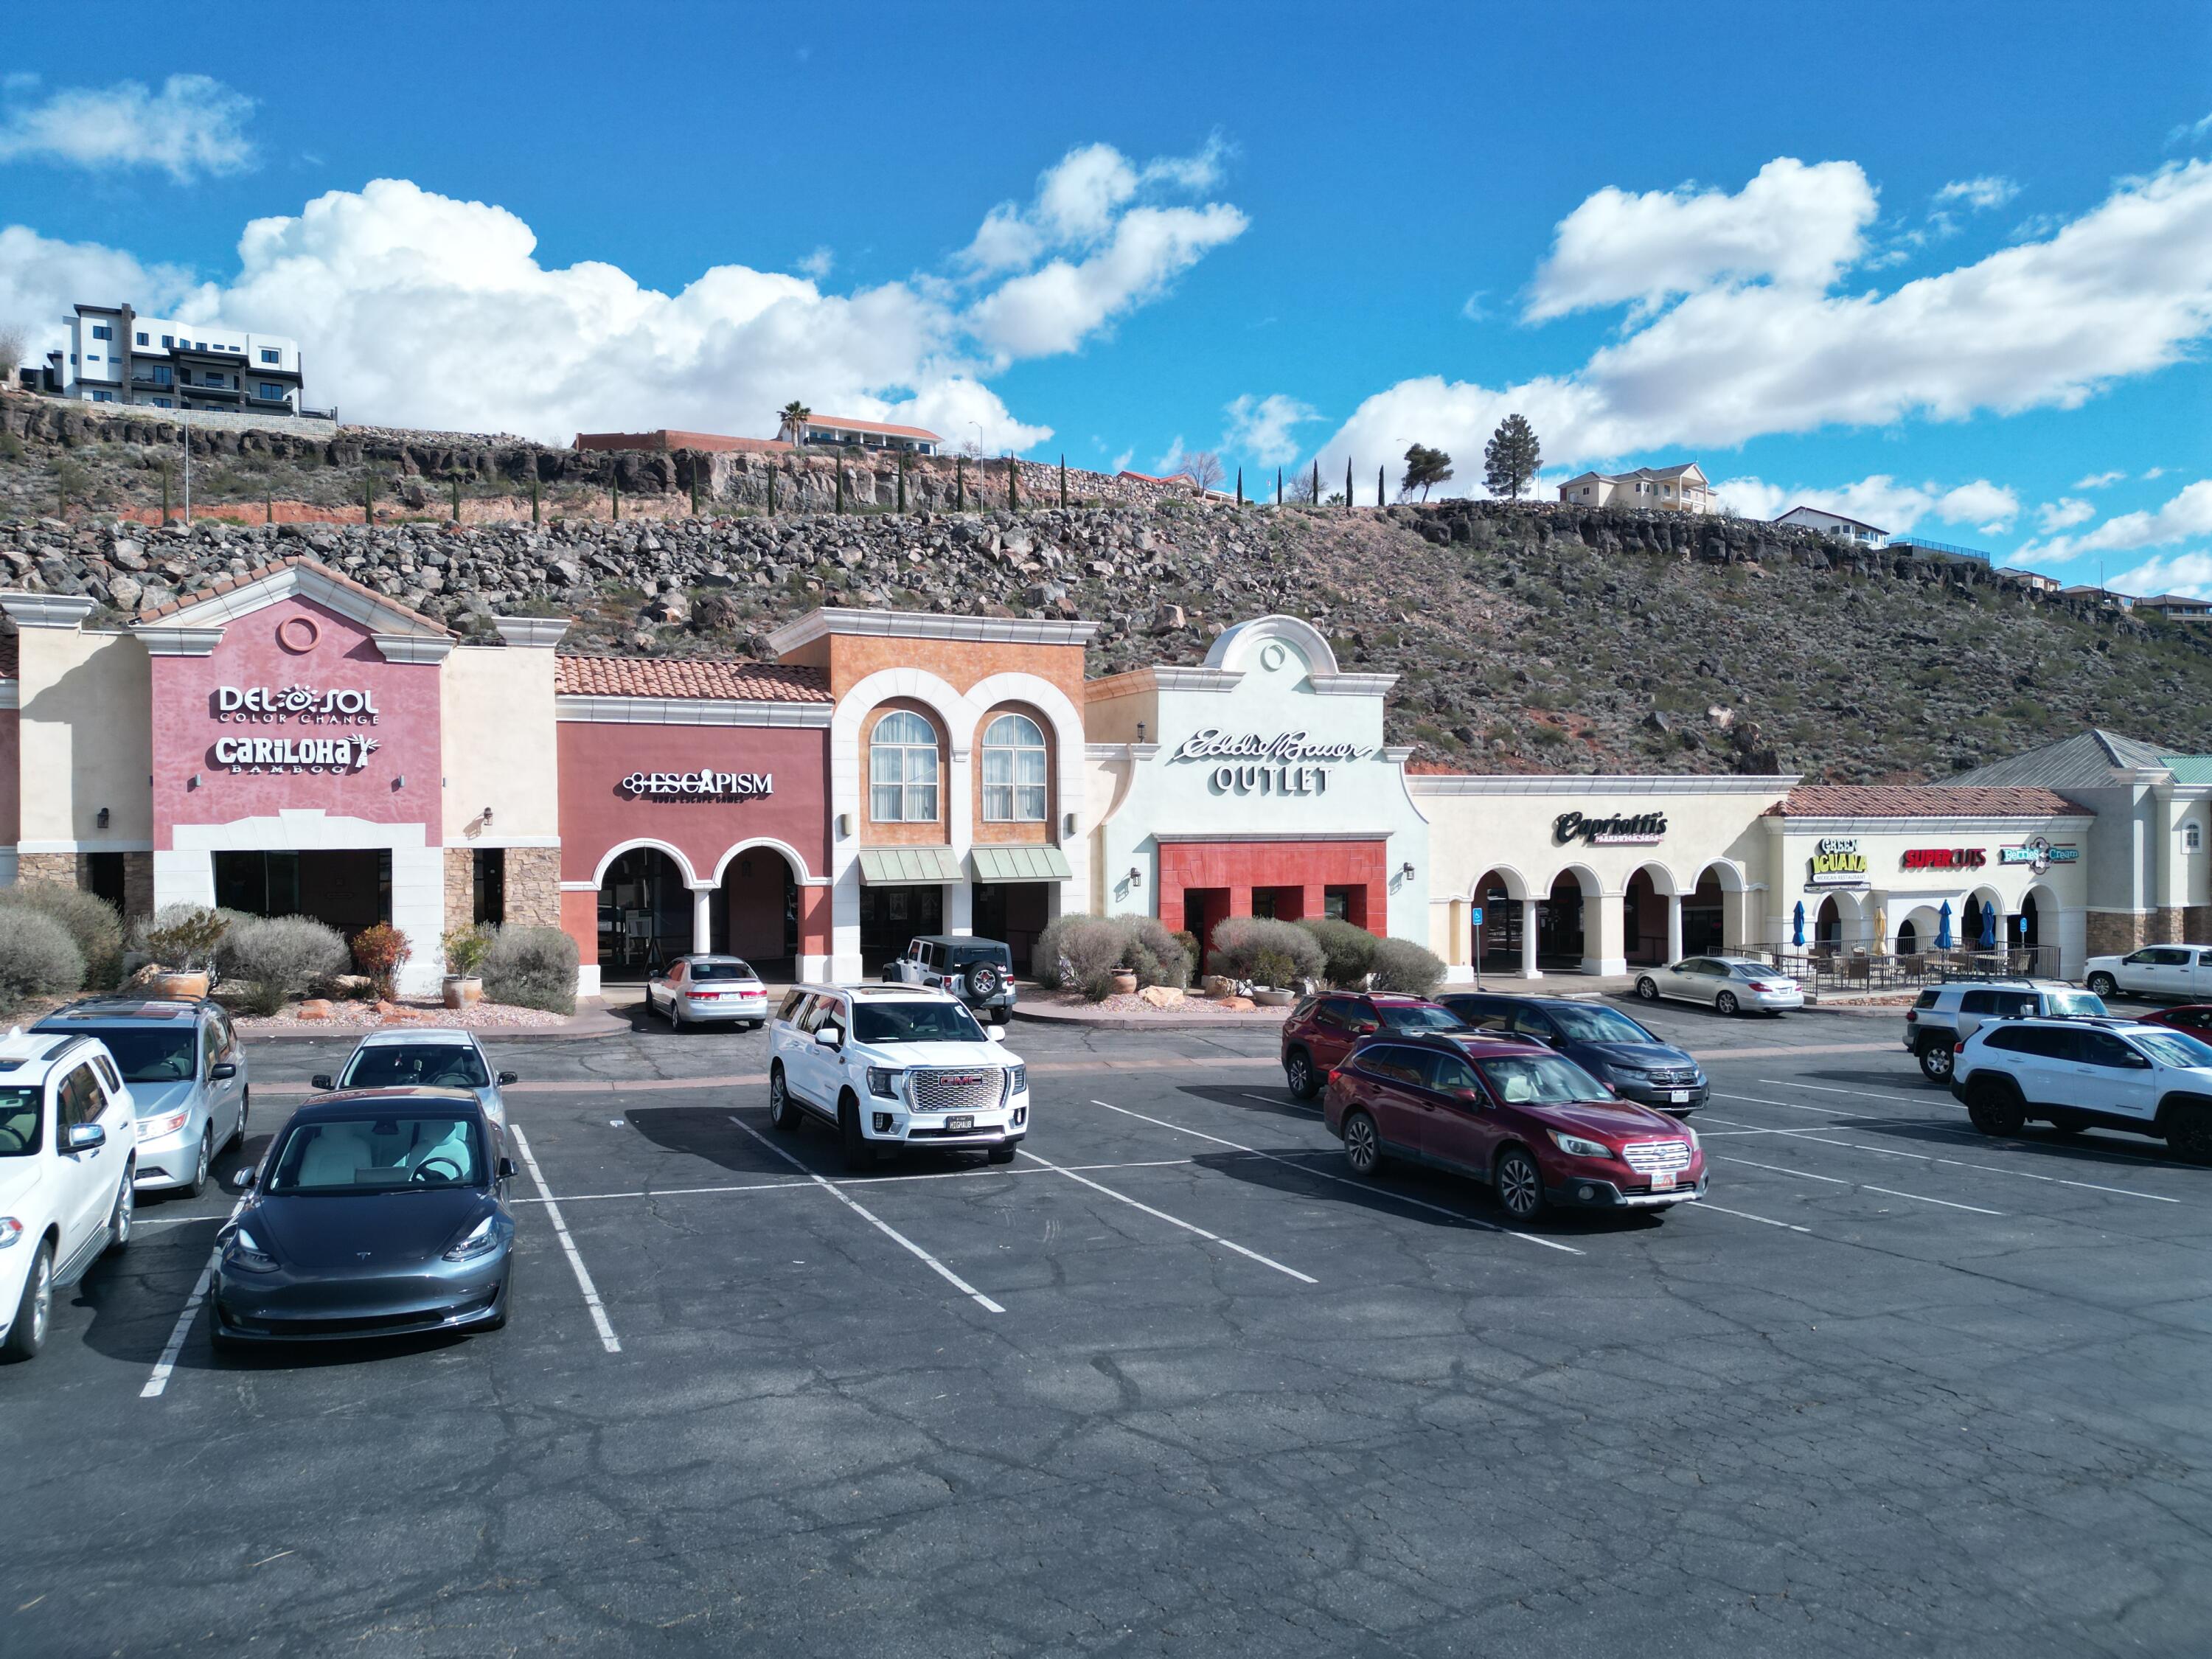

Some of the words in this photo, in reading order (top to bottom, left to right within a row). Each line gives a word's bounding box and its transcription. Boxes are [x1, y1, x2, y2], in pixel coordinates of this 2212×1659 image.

[220, 686, 276, 712] DEL
[320, 689, 379, 714] SOL
[220, 713, 286, 723] COLOR
[301, 714, 379, 724] CHANGE
[1173, 727, 1285, 761] Eddie
[1275, 729, 1374, 761] Bauer
[232, 765, 344, 773] BAMBOO
[1216, 765, 1334, 791] OUTLET
[649, 768, 774, 794] ESCAPISM
[652, 795, 676, 804] ROOM
[680, 795, 713, 804] ESCAPE
[715, 795, 745, 804] GAMES
[1557, 811, 1669, 844] Capriotti's
[1821, 838, 1859, 854] GREEN
[2004, 847, 2039, 861] Berries
[2049, 849, 2079, 859] Cream
[1812, 853, 1868, 874] IGUANA
[1905, 848, 1987, 869] SUPERCUTS
[940, 1076, 981, 1086] GMC
